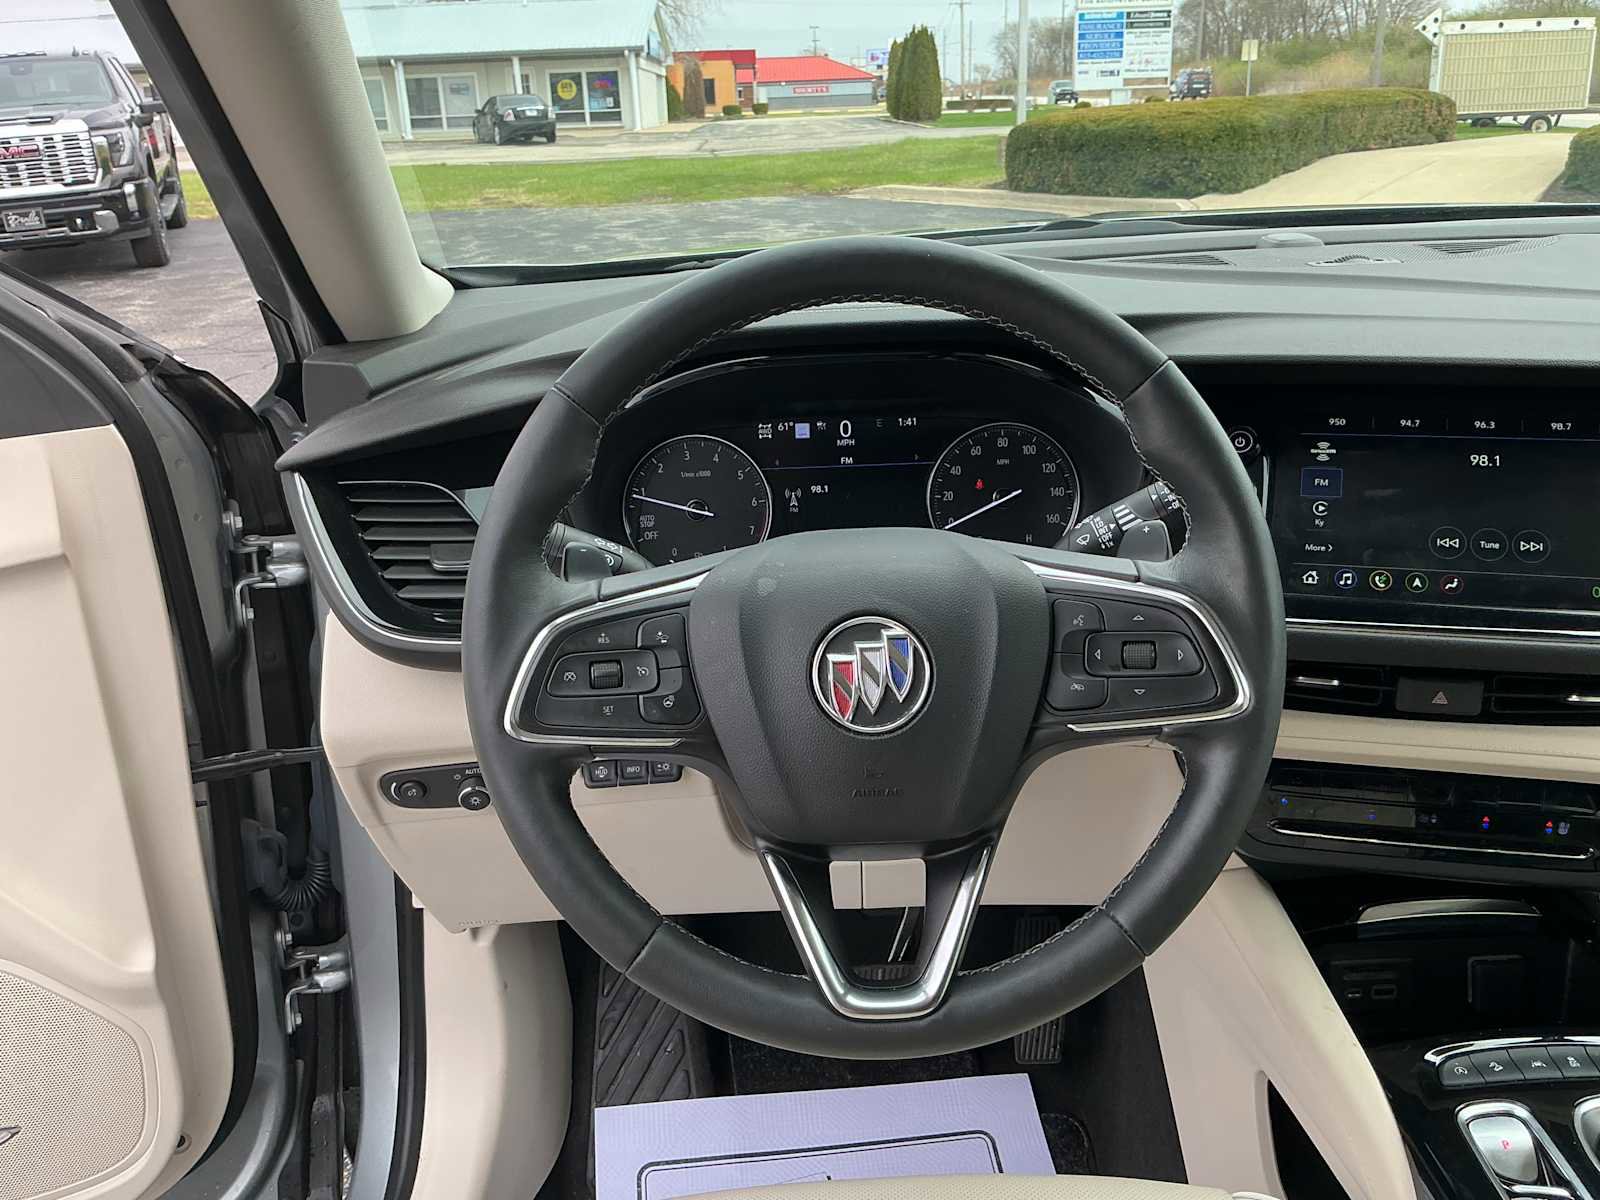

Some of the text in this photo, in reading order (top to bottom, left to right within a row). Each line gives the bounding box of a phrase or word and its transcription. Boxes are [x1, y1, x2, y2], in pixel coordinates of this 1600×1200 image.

[898, 417, 917, 426] 1:41
[1328, 418, 1346, 426] 950
[1400, 419, 1420, 427] 94.7
[1474, 421, 1495, 429] 96.3
[839, 419, 852, 437] 0
[1550, 422, 1572, 431] 98.7
[836, 439, 856, 447] MPH
[997, 437, 1009, 447] 80
[970, 446, 981, 455] 60
[1022, 445, 1036, 455] 100
[684, 451, 690, 460] 3
[712, 453, 719, 462] 4
[1470, 454, 1500, 467] 98.1
[657, 463, 664, 473] 2
[950, 466, 962, 475] 40
[1042, 463, 1056, 473] 120
[737, 471, 744, 480] 5
[1314, 478, 1329, 487] FM
[810, 484, 829, 493] 98.1
[1050, 487, 1065, 496] 140
[943, 491, 954, 501] 20
[751, 497, 758, 506] 6
[1046, 514, 1060, 523] 160
[1315, 518, 1325, 527] Ky
[749, 526, 755, 535] 7
[644, 531, 659, 540] OFF
[1025, 534, 1033, 543] H
[1304, 544, 1327, 552] More
[1479, 541, 1500, 549] Tune
[671, 547, 678, 557] 0
[1501, 1139, 1511, 1150] P
